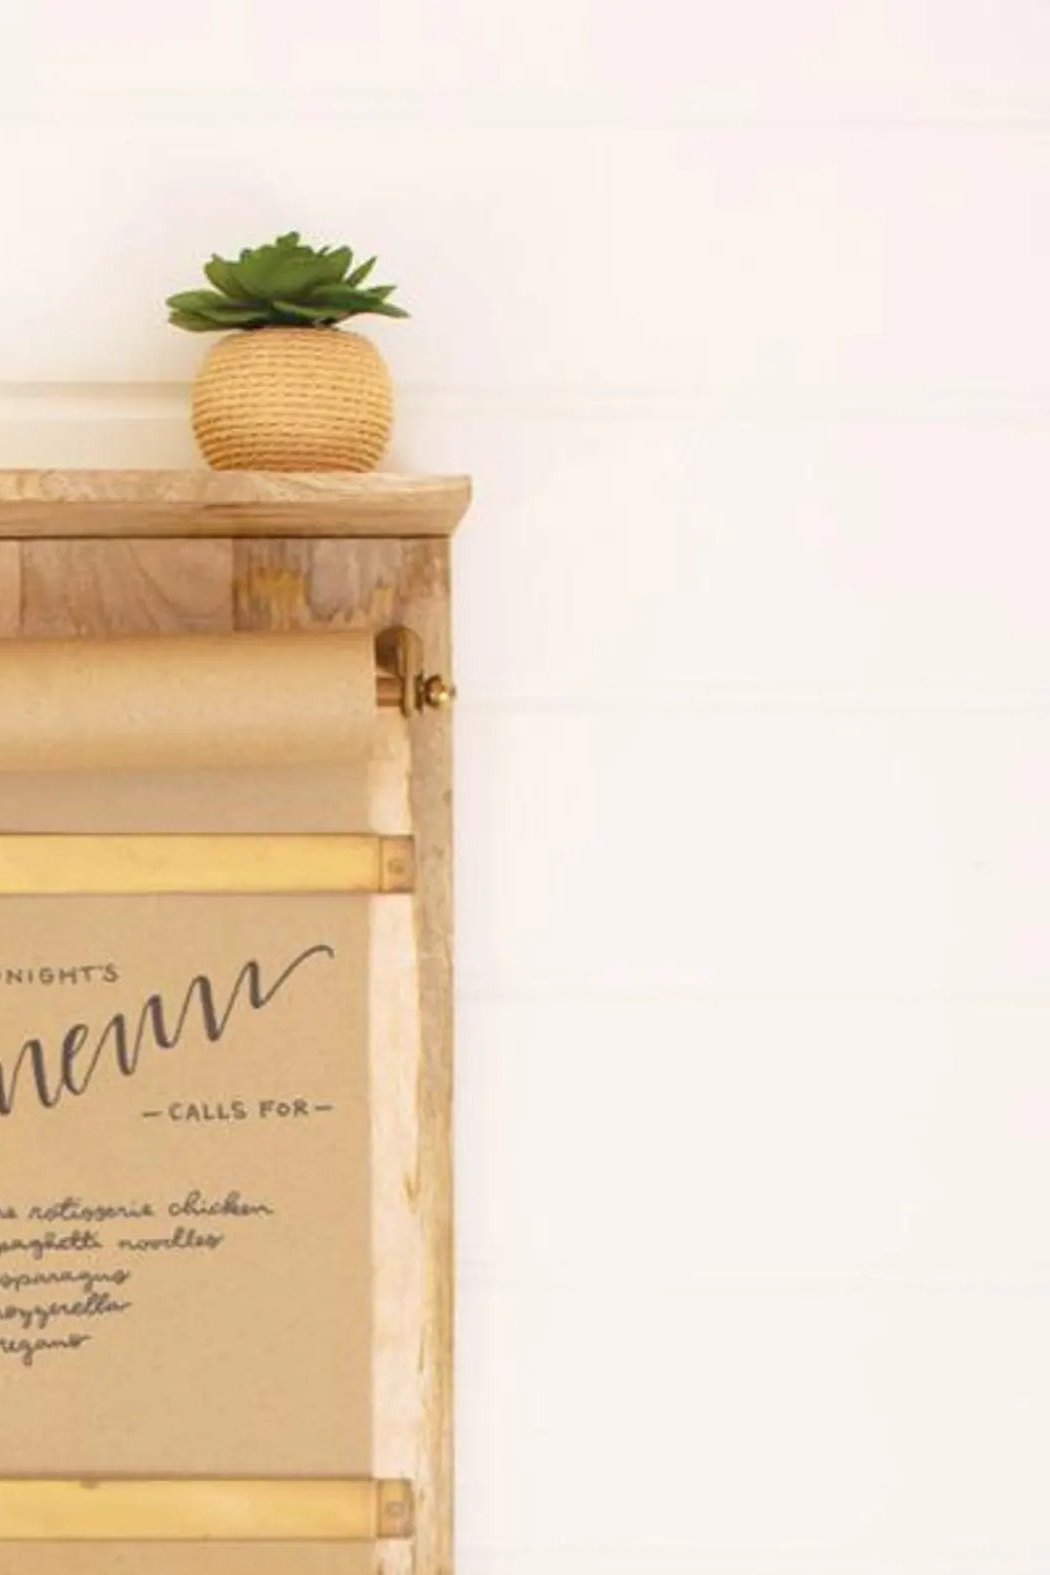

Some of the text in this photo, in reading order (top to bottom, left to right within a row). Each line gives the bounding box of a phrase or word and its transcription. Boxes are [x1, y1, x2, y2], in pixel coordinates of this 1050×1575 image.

[168, 1098, 309, 1122] CALLS FOR
[27, 1197, 155, 1222] rotisserie
[167, 1189, 275, 1218] chicken
[117, 1226, 225, 1251] noodles
